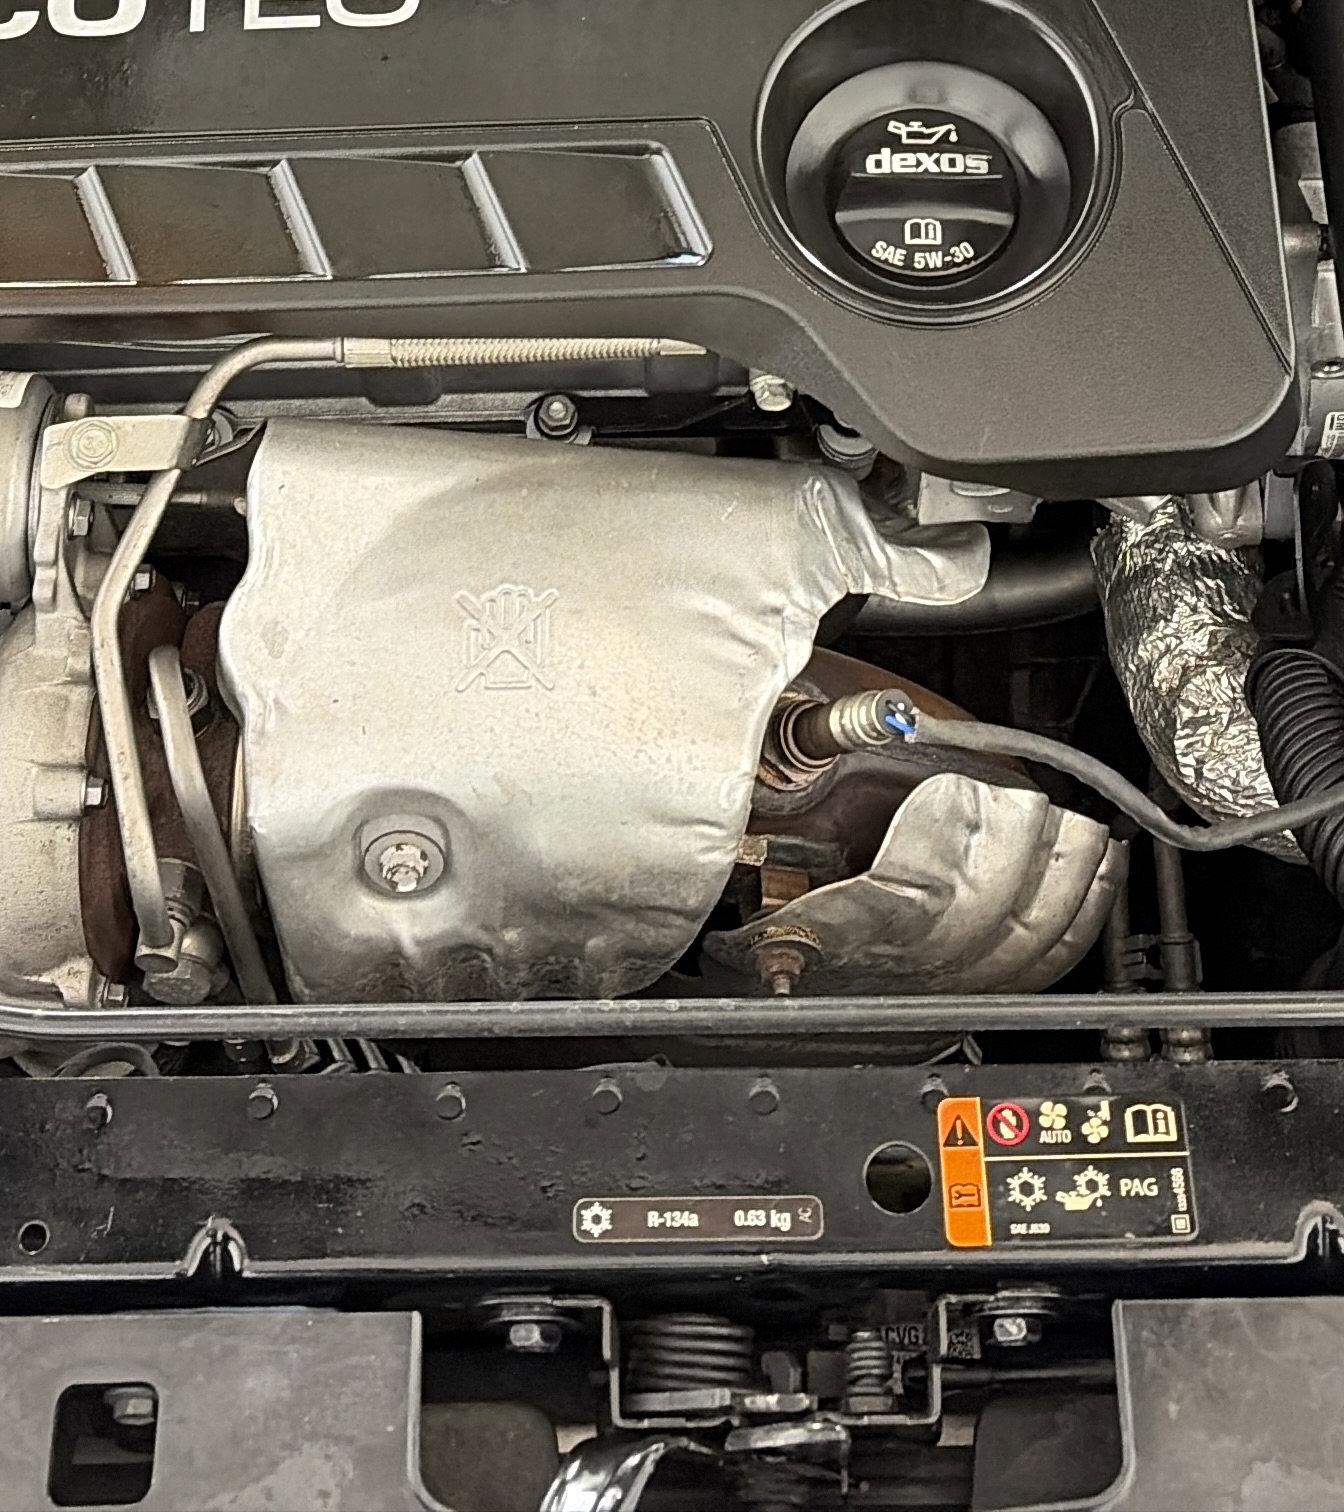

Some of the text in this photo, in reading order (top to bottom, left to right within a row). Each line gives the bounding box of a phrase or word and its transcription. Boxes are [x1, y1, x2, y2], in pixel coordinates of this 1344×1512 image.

[866, 148, 989, 174] dexos
[871, 241, 975, 270] SAE 5W-30
[1039, 1130, 1072, 1144] AUTO
[1119, 1177, 1159, 1197] PAG
[647, 1211, 699, 1228] R-134a
[734, 1210, 766, 1227] 0.63
[771, 1210, 792, 1231] kg
